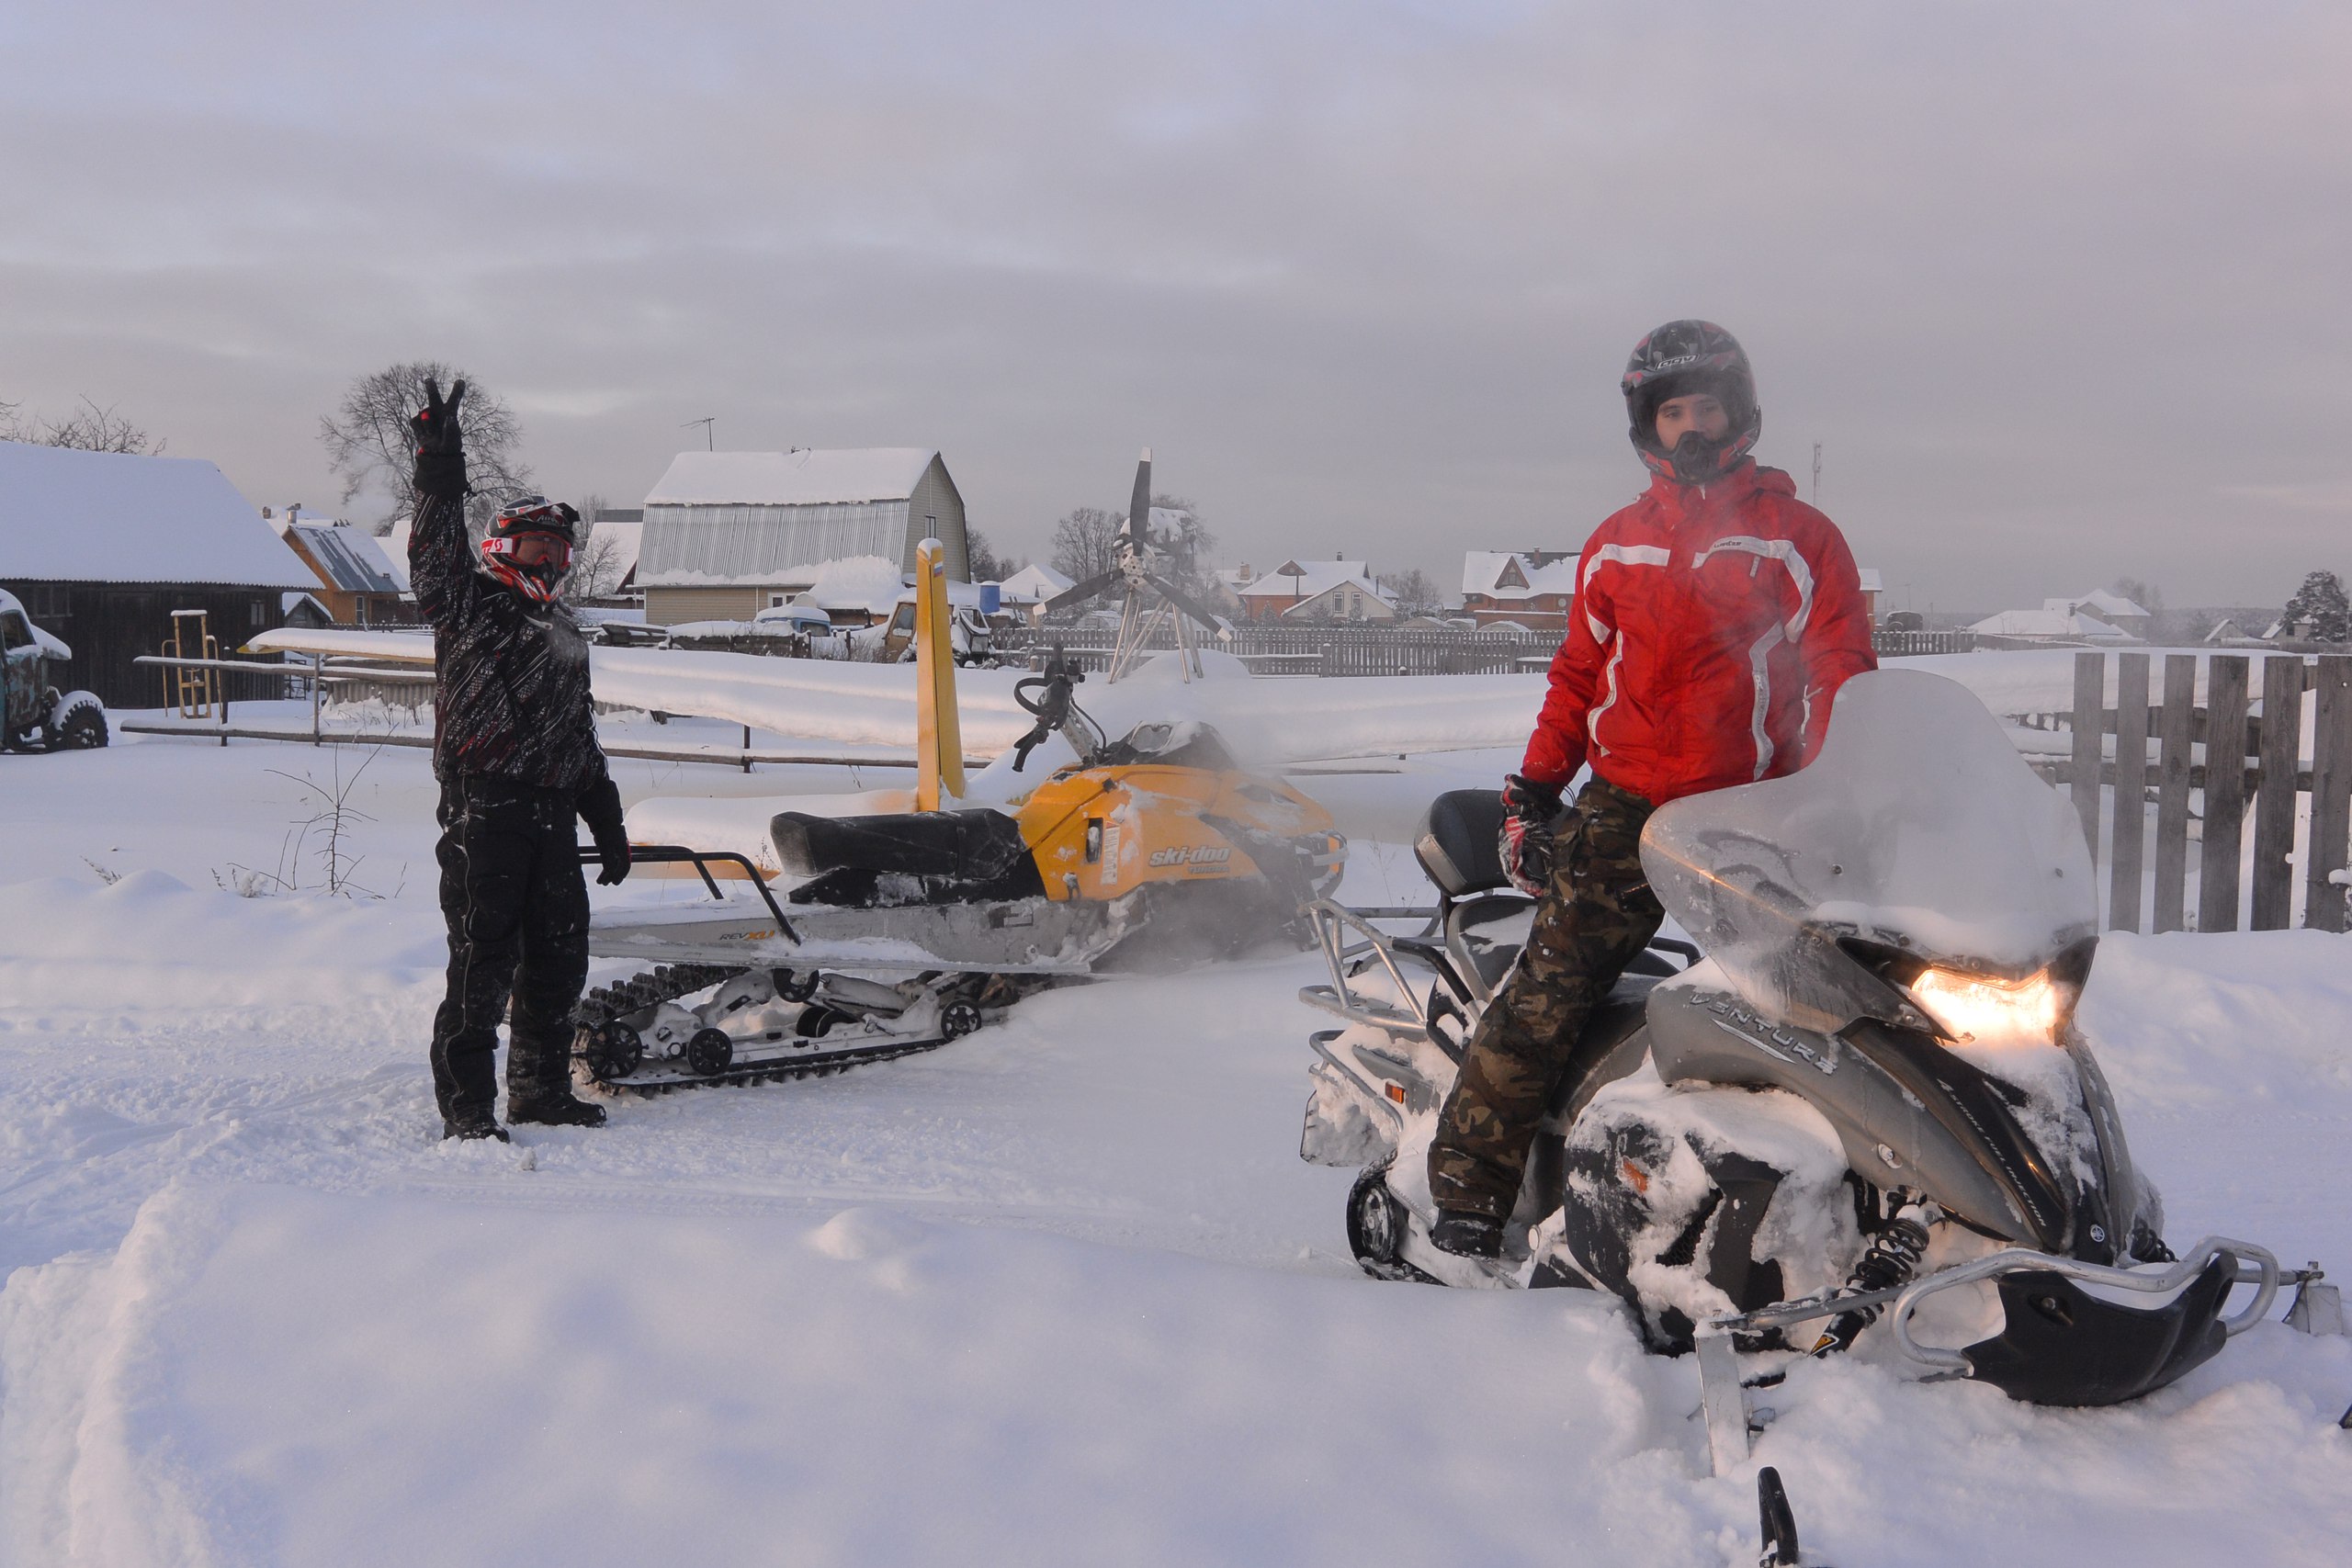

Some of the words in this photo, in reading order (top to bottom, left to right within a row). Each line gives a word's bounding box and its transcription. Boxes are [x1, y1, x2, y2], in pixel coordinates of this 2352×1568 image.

[1149, 846, 1230, 866] ski-doo
[1689, 992, 1838, 1076] VENTURE
[1950, 1093, 1986, 1134] STROKE
[1984, 1135, 2006, 1162] FUEL
[2006, 1165, 2048, 1227] INJECTION
